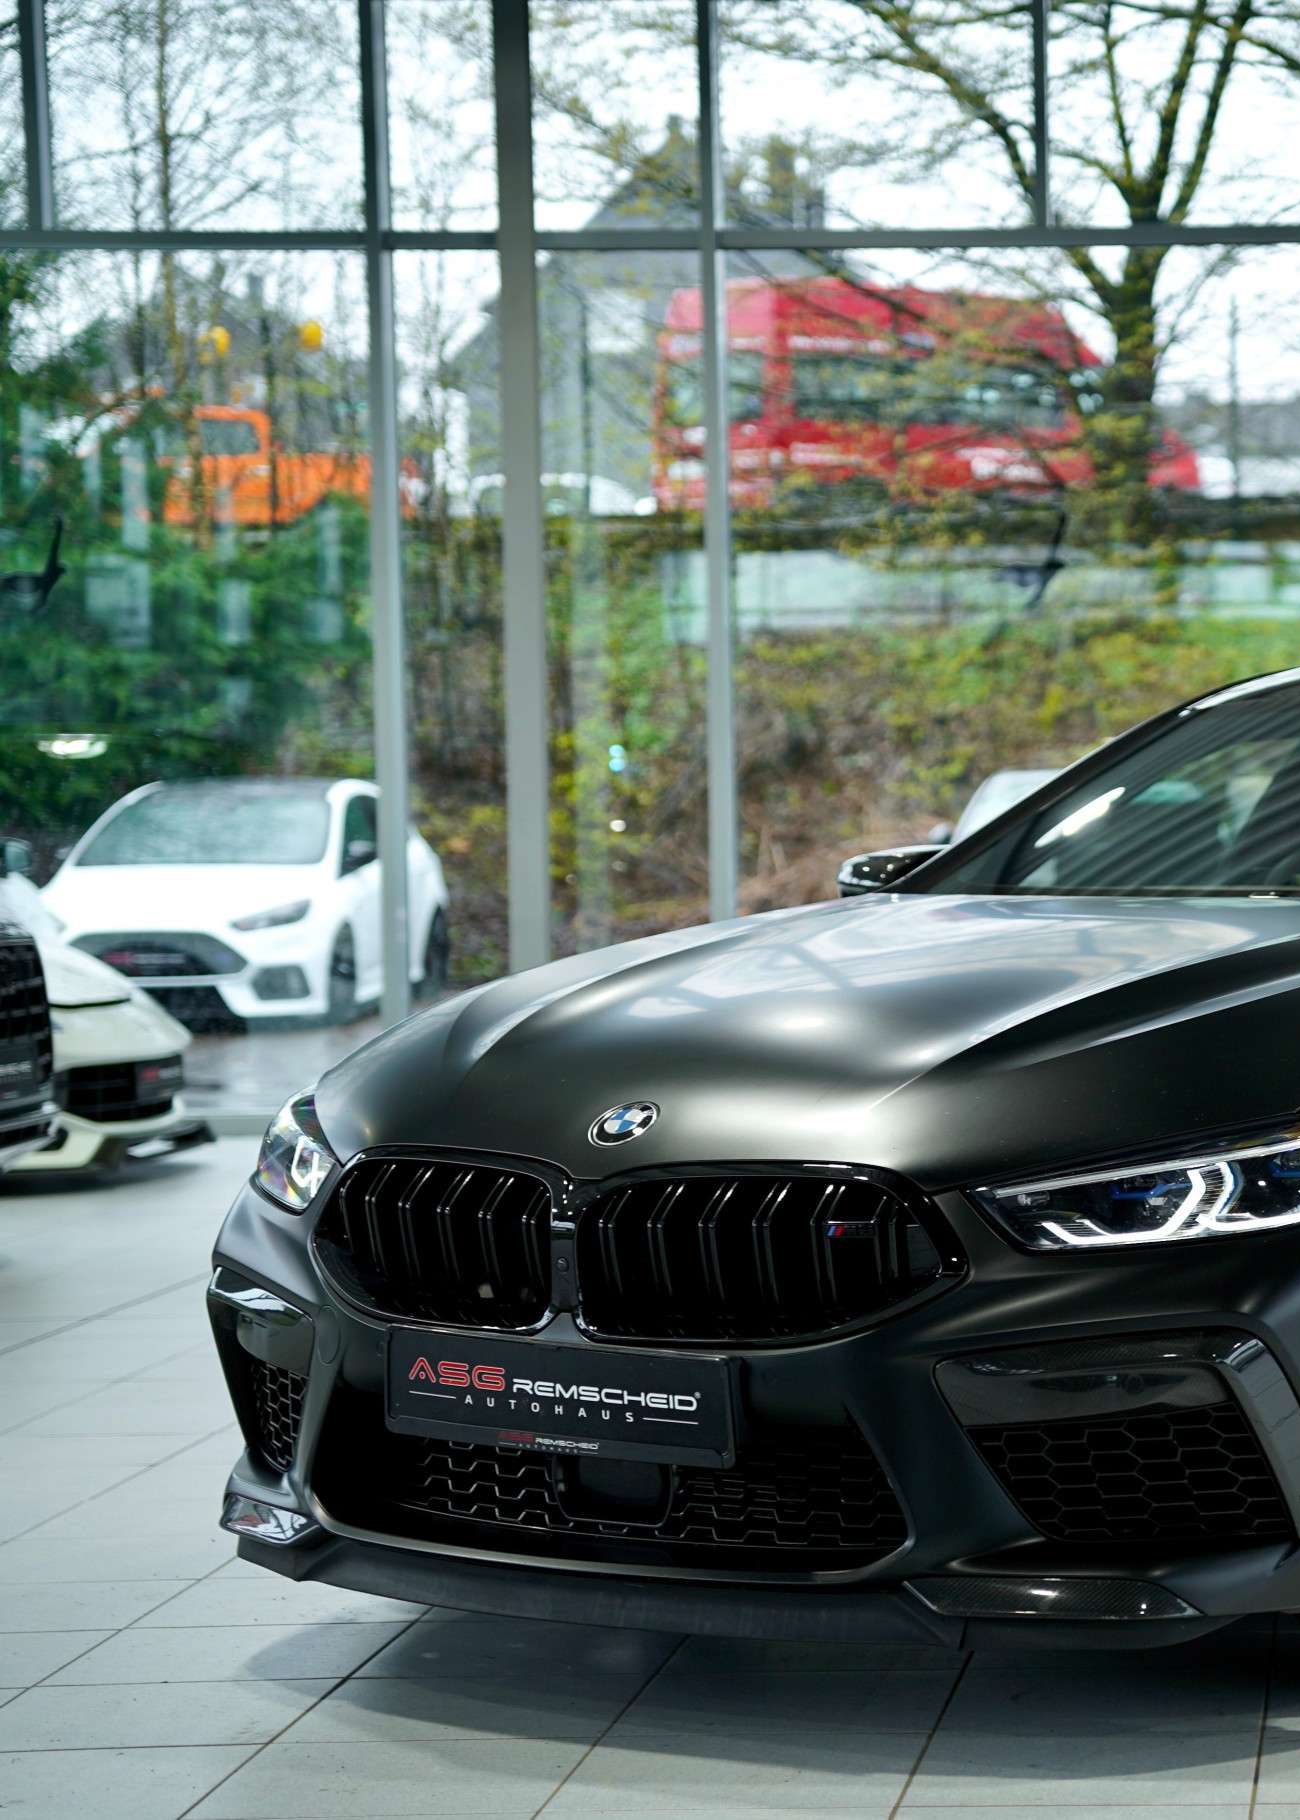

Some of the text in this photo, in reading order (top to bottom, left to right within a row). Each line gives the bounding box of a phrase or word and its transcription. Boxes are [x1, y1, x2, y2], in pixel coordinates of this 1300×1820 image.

[408, 1357, 698, 1412] ASG REMSCHEID
[463, 1394, 635, 1423] AUTOHAUS
